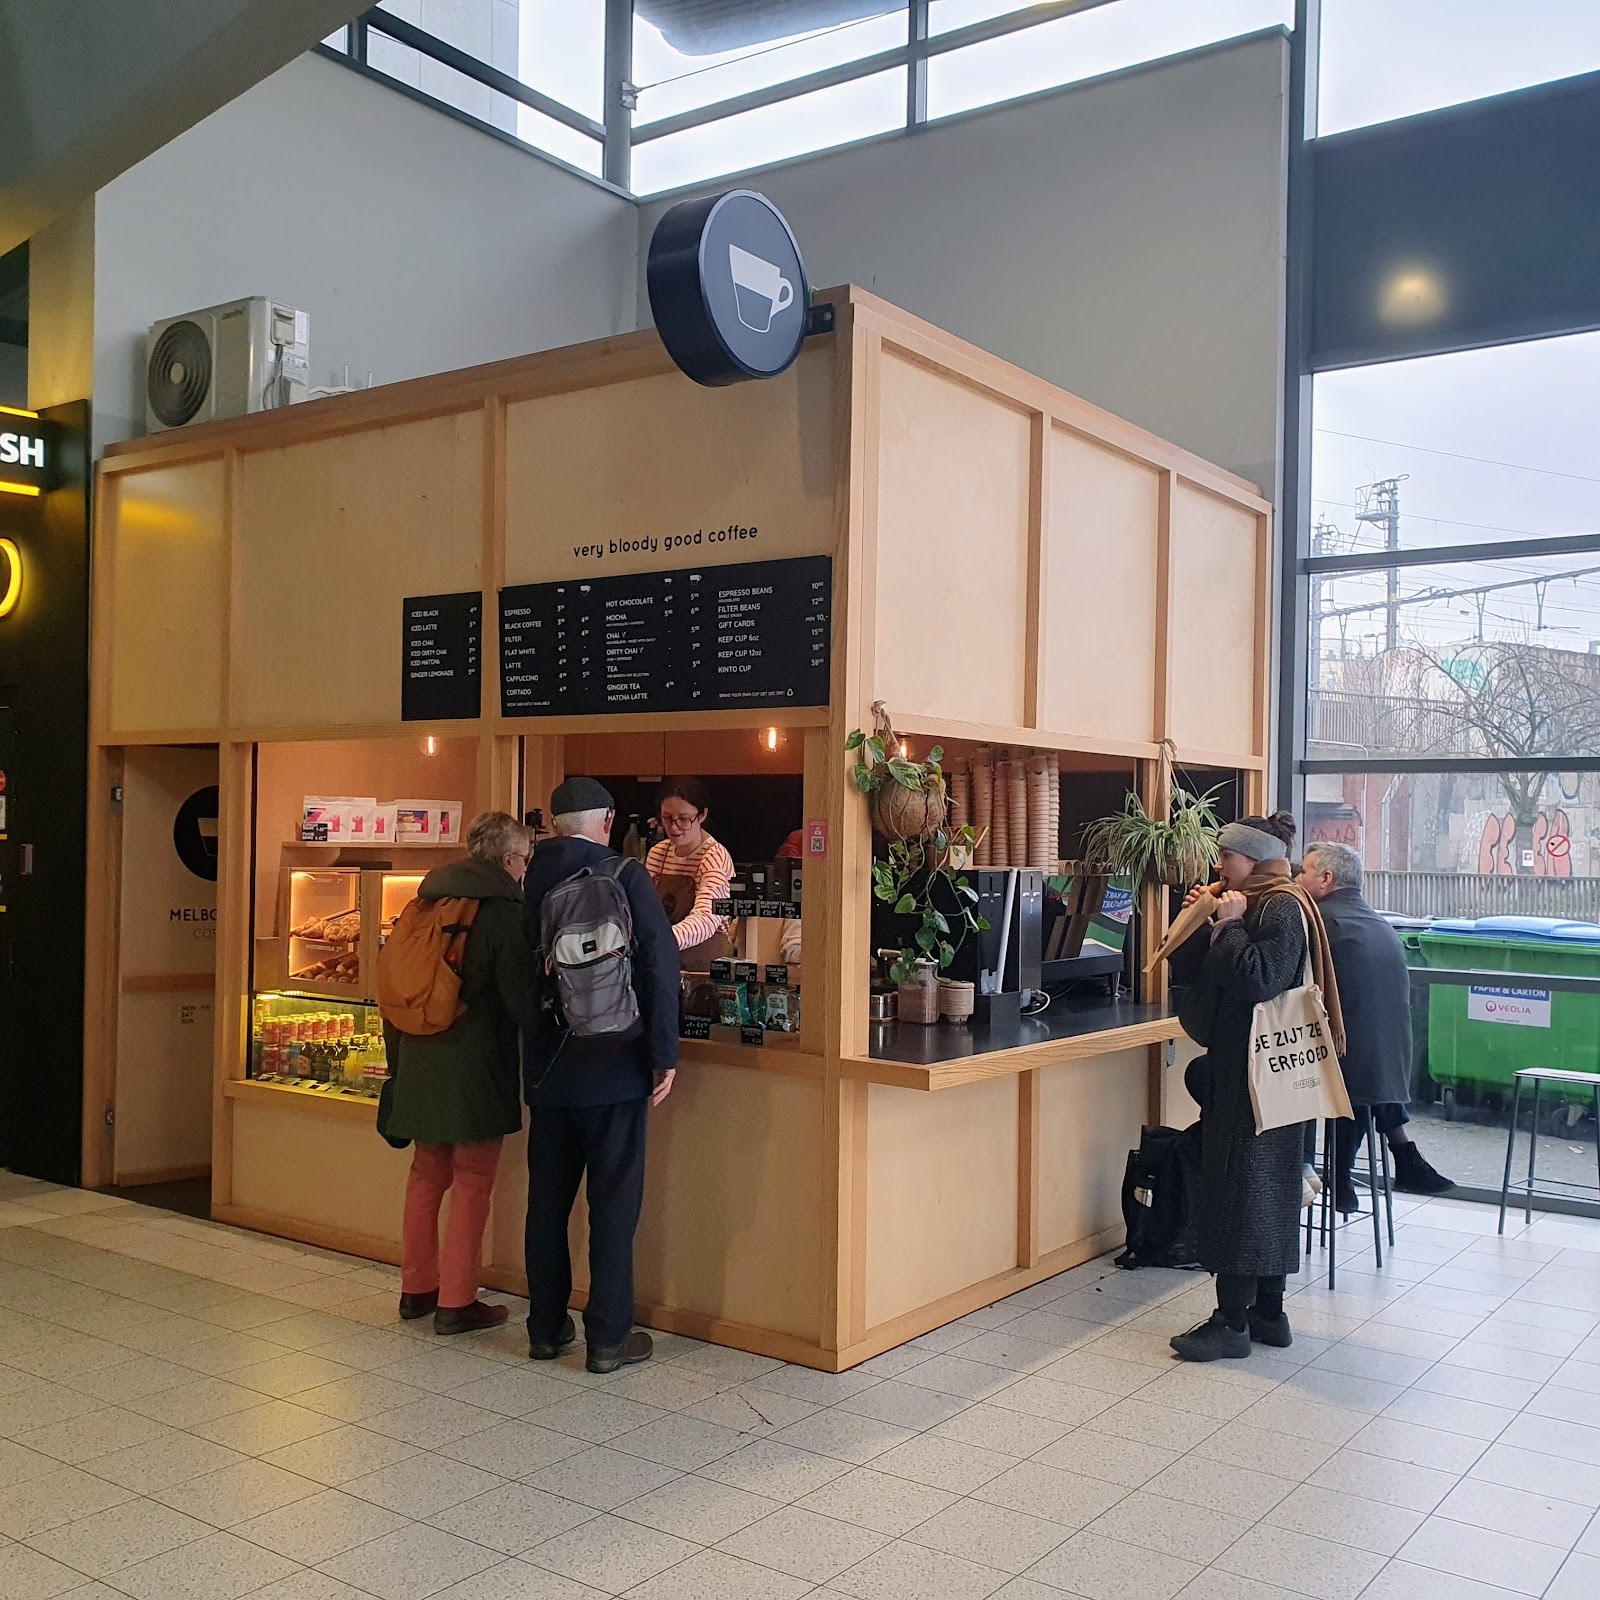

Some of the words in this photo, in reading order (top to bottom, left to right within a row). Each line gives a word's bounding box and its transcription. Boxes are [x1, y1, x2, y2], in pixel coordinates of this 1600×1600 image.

[574, 544, 603, 558] very
[610, 536, 657, 553] bloody
[664, 529, 701, 551] good
[708, 525, 757, 542] coffee
[719, 589, 750, 598] ESPRESSO
[752, 586, 773, 595] BEANS
[619, 597, 653, 606] CHOCOLATE
[504, 608, 531, 616] ESPRESSO
[718, 605, 738, 613] FILTER
[740, 603, 760, 611] BEANS
[734, 620, 755, 628] CARDS
[1499, 1005, 1531, 1014] VEOLIA
[1273, 1026, 1303, 1047] ZIJT
[1306, 1022, 1322, 1038] ZE
[1269, 1045, 1328, 1073] ERFGOED
